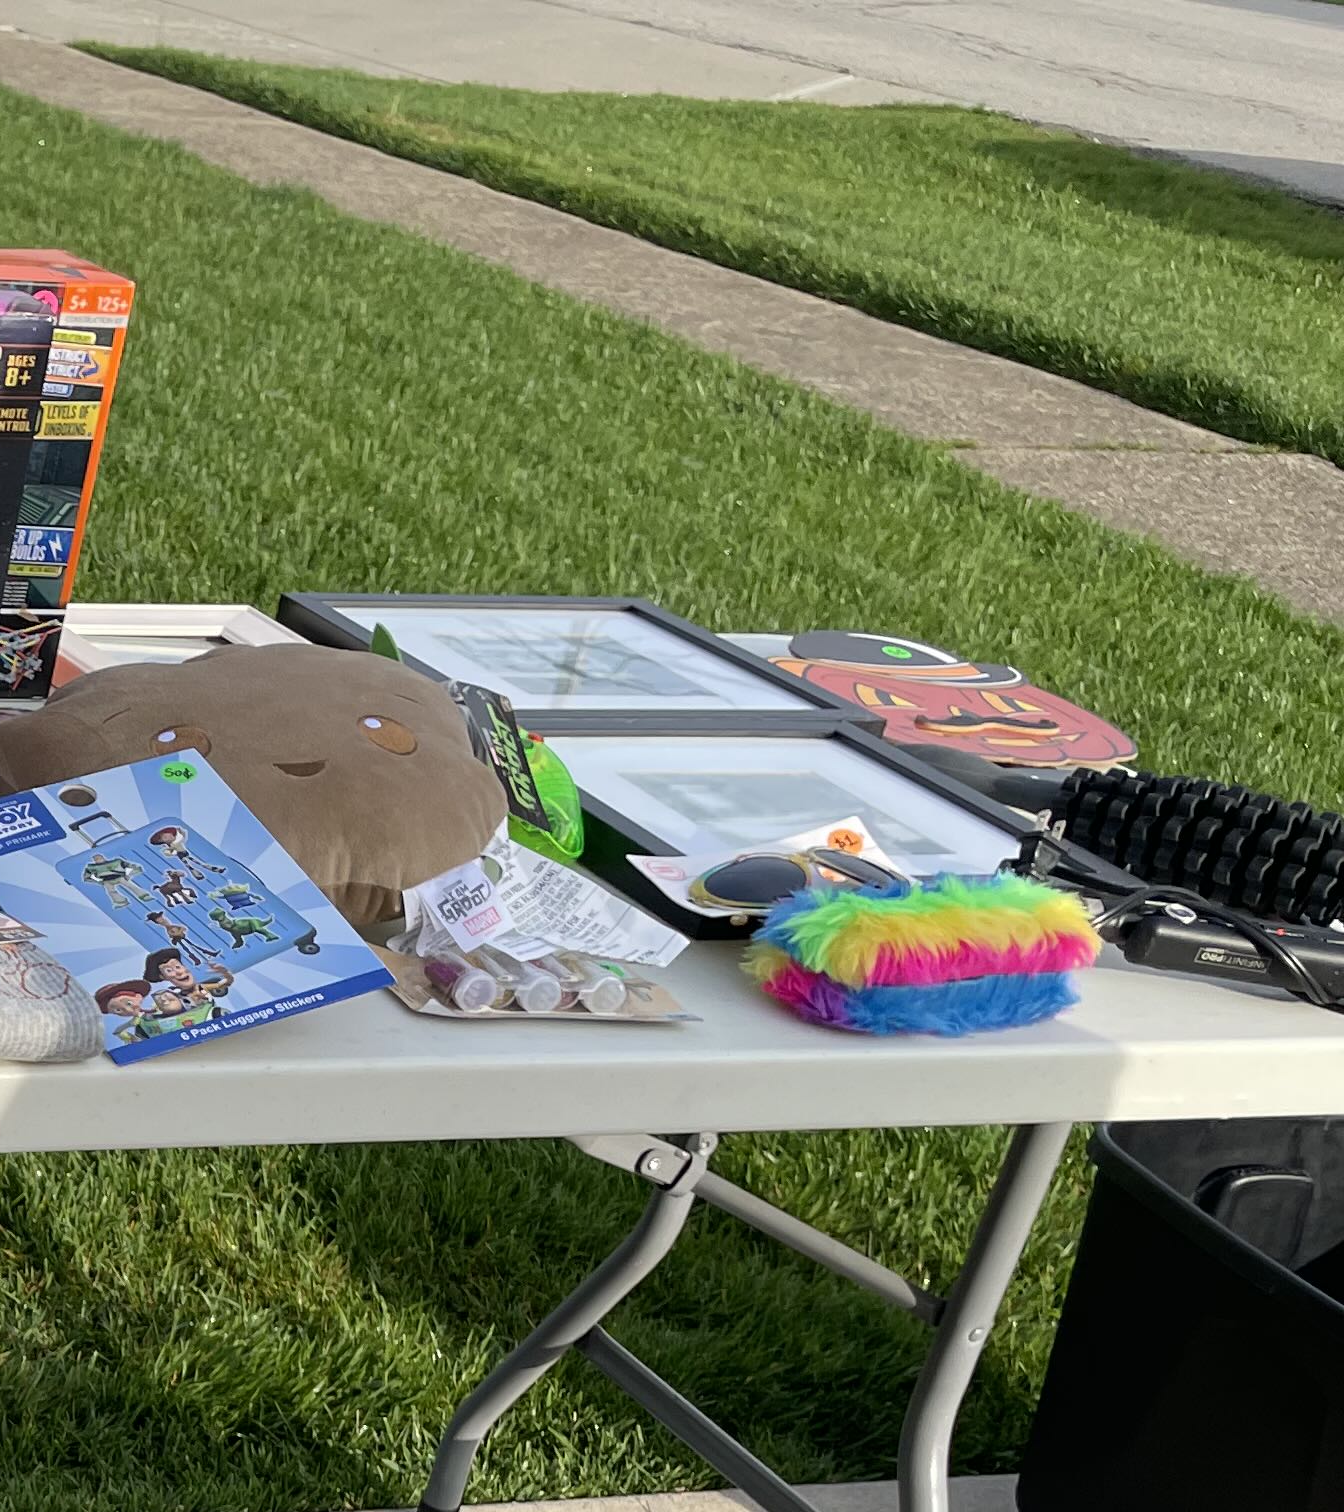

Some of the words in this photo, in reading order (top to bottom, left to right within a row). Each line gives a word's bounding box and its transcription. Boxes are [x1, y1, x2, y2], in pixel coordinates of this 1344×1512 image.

[7, 354, 37, 367] AGES
[4, 367, 32, 387] 8+
[5, 829, 51, 848] PRIMARK
[180, 1031, 190, 1042] 6
[192, 1023, 222, 1039] Pack
[223, 1005, 274, 1029] Luggage
[274, 992, 325, 1013] Stickers
